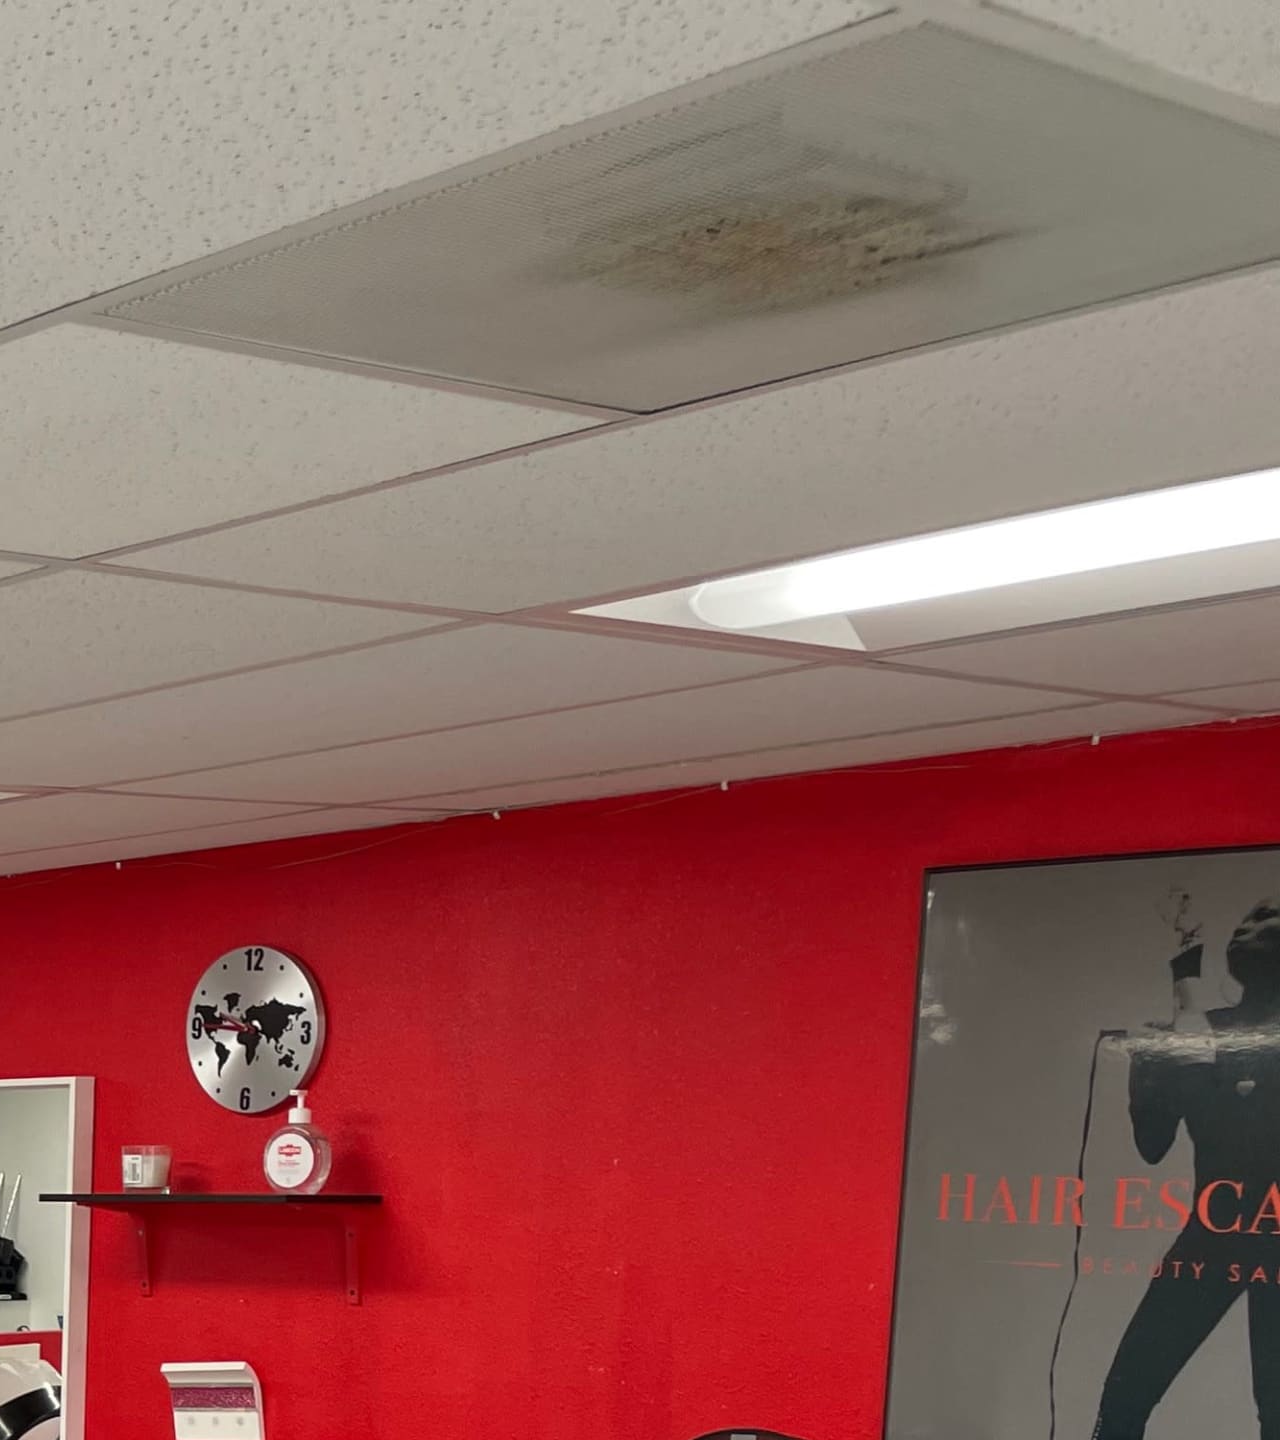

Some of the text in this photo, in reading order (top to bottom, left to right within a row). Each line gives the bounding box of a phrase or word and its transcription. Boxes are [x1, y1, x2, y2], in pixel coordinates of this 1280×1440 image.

[244, 948, 264, 972] 12
[191, 1017, 203, 1040] 9
[300, 1021, 311, 1046] 3
[239, 1087, 250, 1111] 6
[936, 1173, 1088, 1227] HAIR
[1081, 1257, 1204, 1280] BEAUTY
